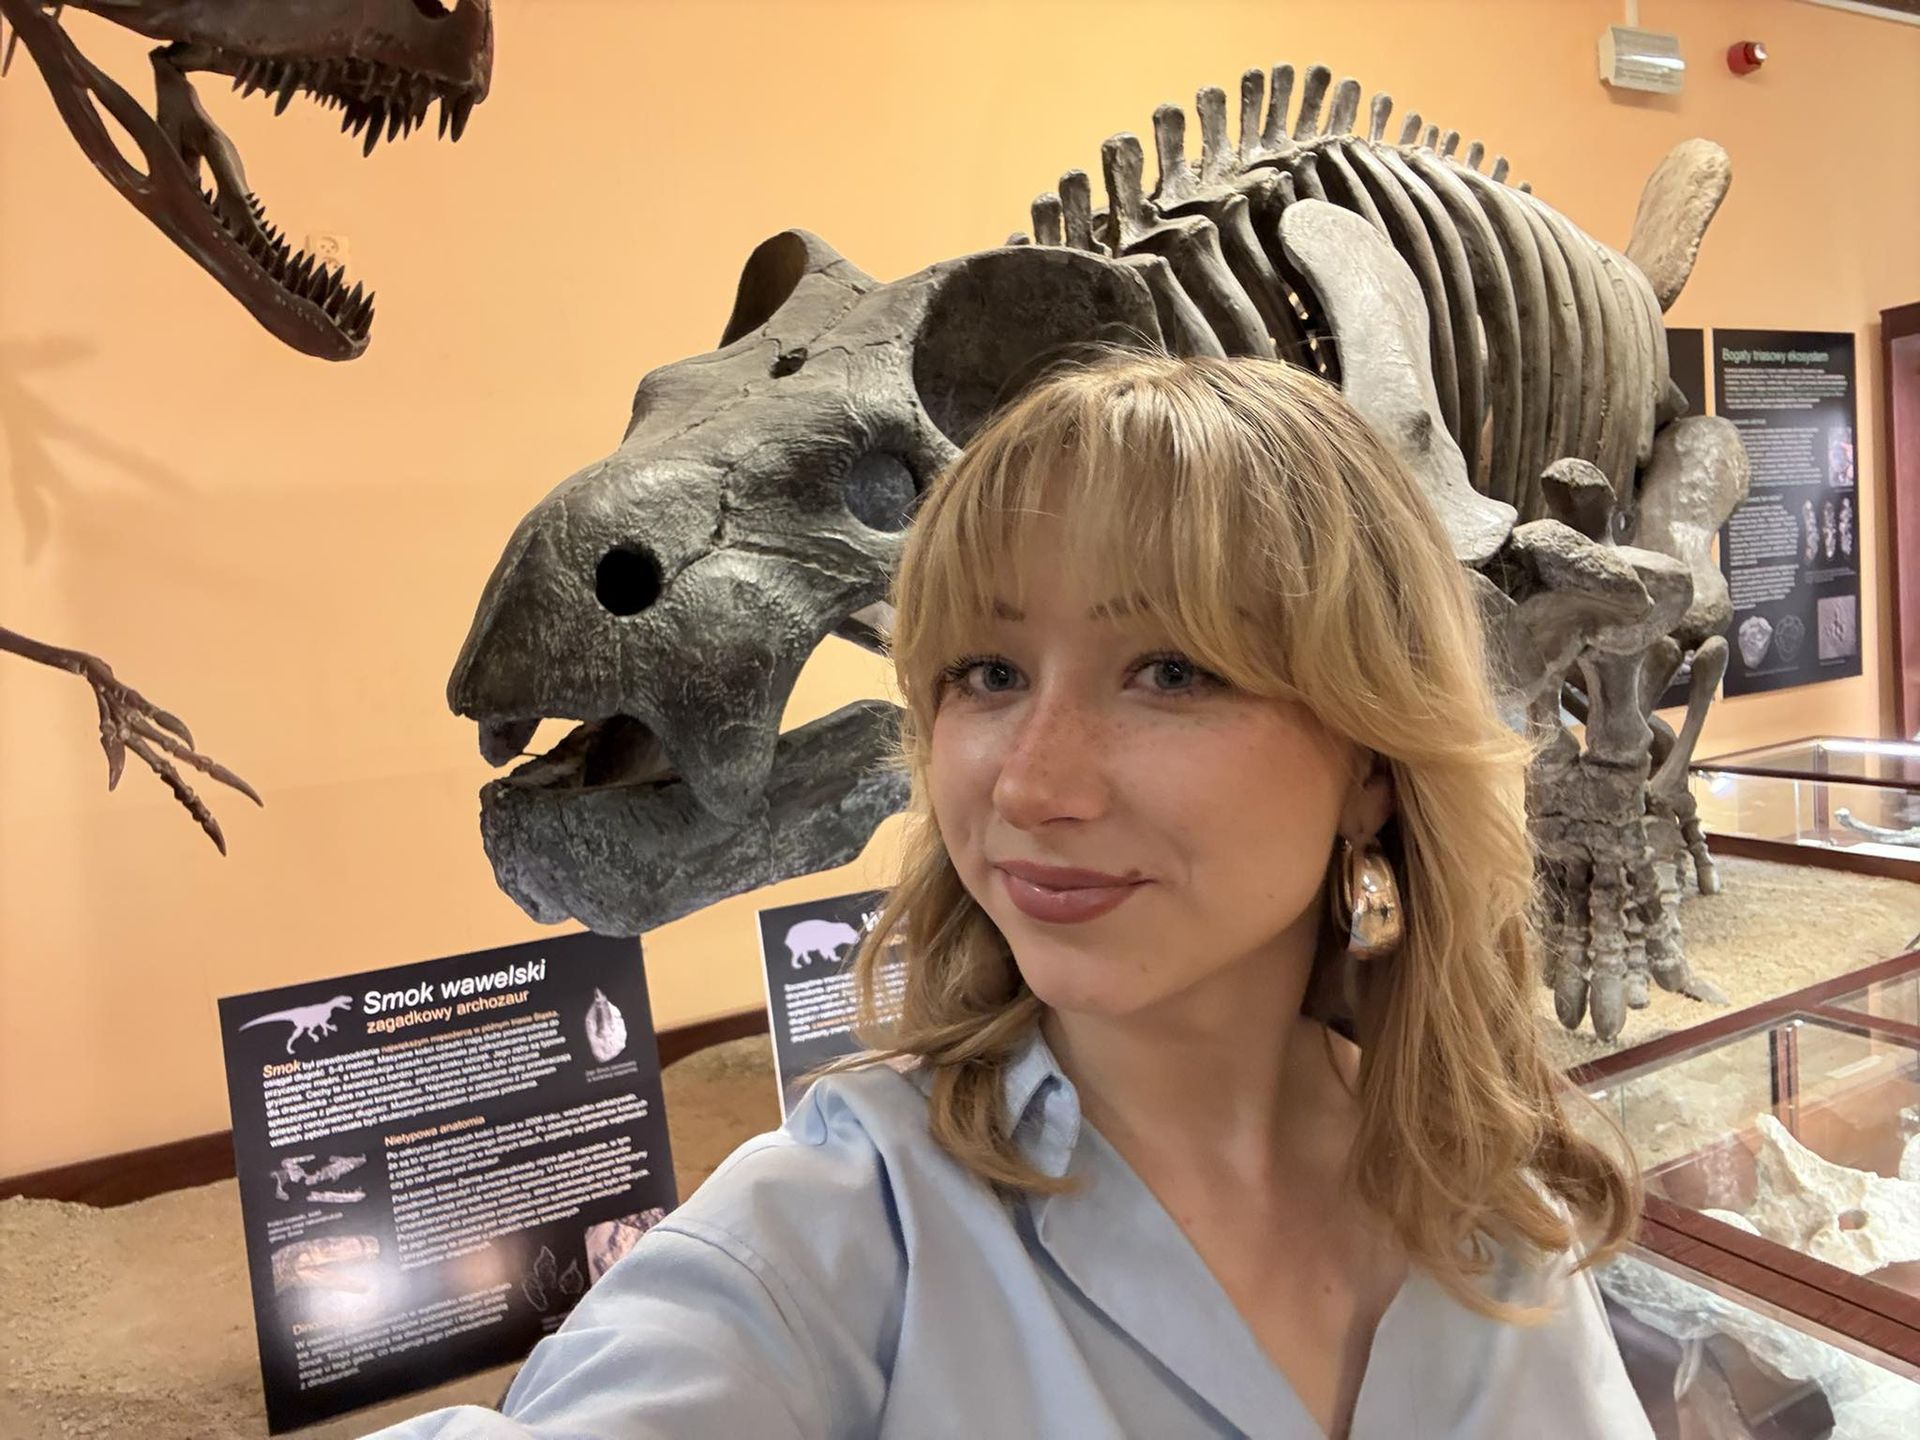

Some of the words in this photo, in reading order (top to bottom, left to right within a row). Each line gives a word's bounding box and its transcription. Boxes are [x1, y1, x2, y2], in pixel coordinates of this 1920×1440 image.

[1722, 348, 1751, 364] Bogaty
[363, 982, 434, 1015] Smok
[440, 959, 546, 999] wawelski
[366, 1005, 452, 1034] zagadkowy
[456, 990, 529, 1015] archozaur
[262, 1060, 301, 1078] Smok
[385, 1127, 437, 1146] Nietypowa
[440, 1116, 485, 1134] anatomia
